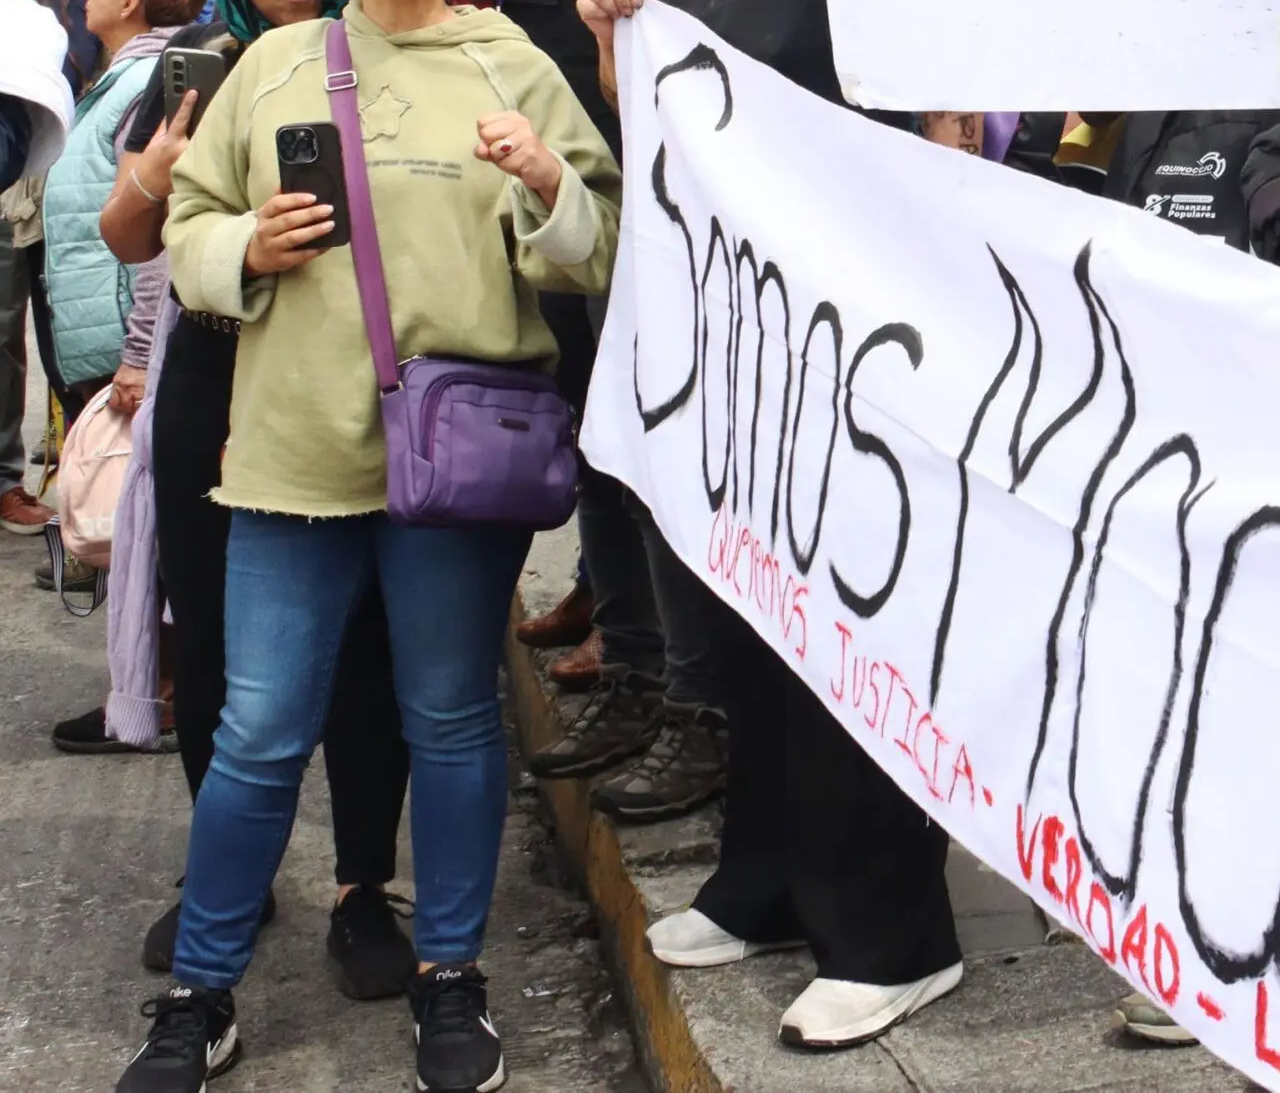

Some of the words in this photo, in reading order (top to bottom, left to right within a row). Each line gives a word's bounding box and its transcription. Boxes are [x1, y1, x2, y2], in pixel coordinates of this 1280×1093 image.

[1168, 210, 1216, 219] Populares
[1170, 204, 1212, 212] Finanzas
[633, 42, 924, 618] Somos
[1016, 803, 1181, 1008] VERDAD
